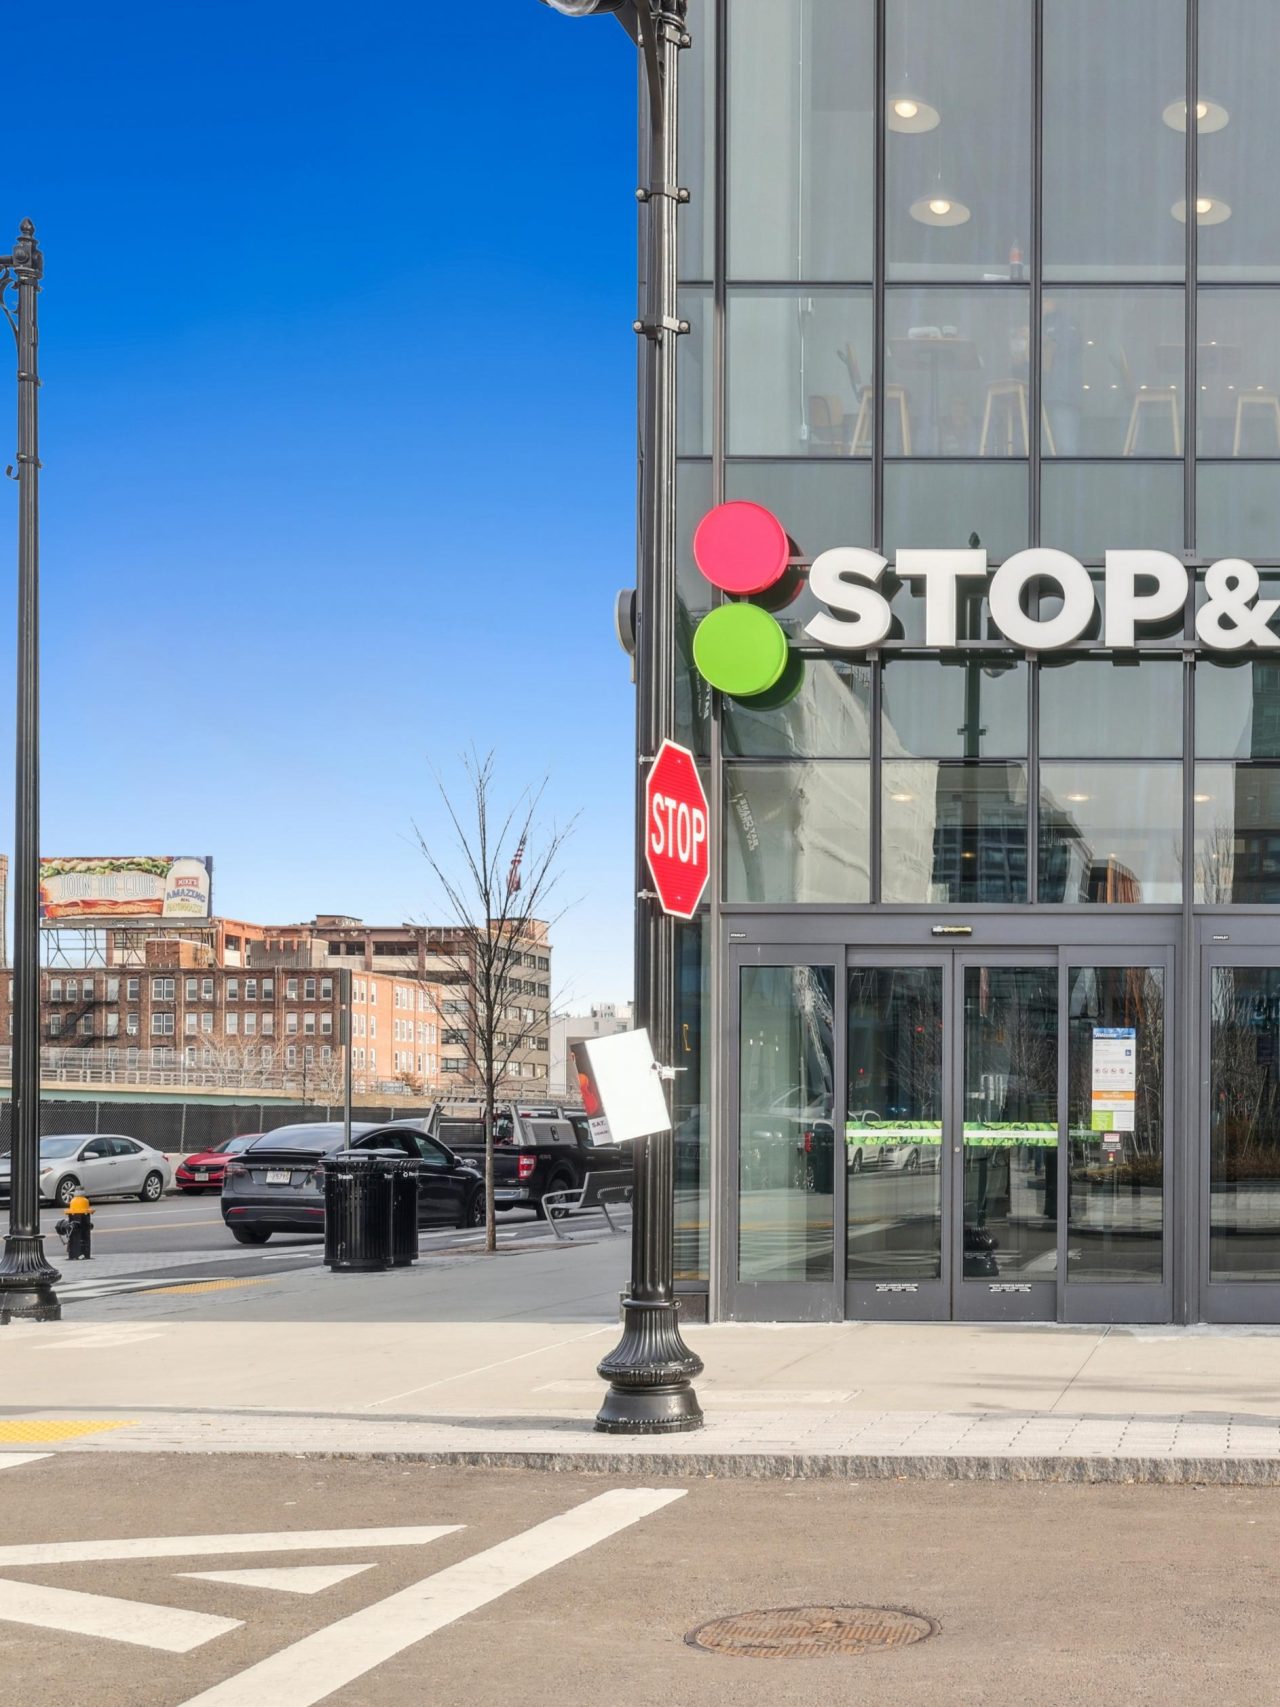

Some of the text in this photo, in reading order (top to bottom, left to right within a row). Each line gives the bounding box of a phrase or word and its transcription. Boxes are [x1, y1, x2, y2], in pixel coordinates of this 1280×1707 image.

[651, 791, 706, 866] STOP
[59, 873, 157, 898] JOIN THE CLUB
[166, 888, 206, 903] AMAZING
